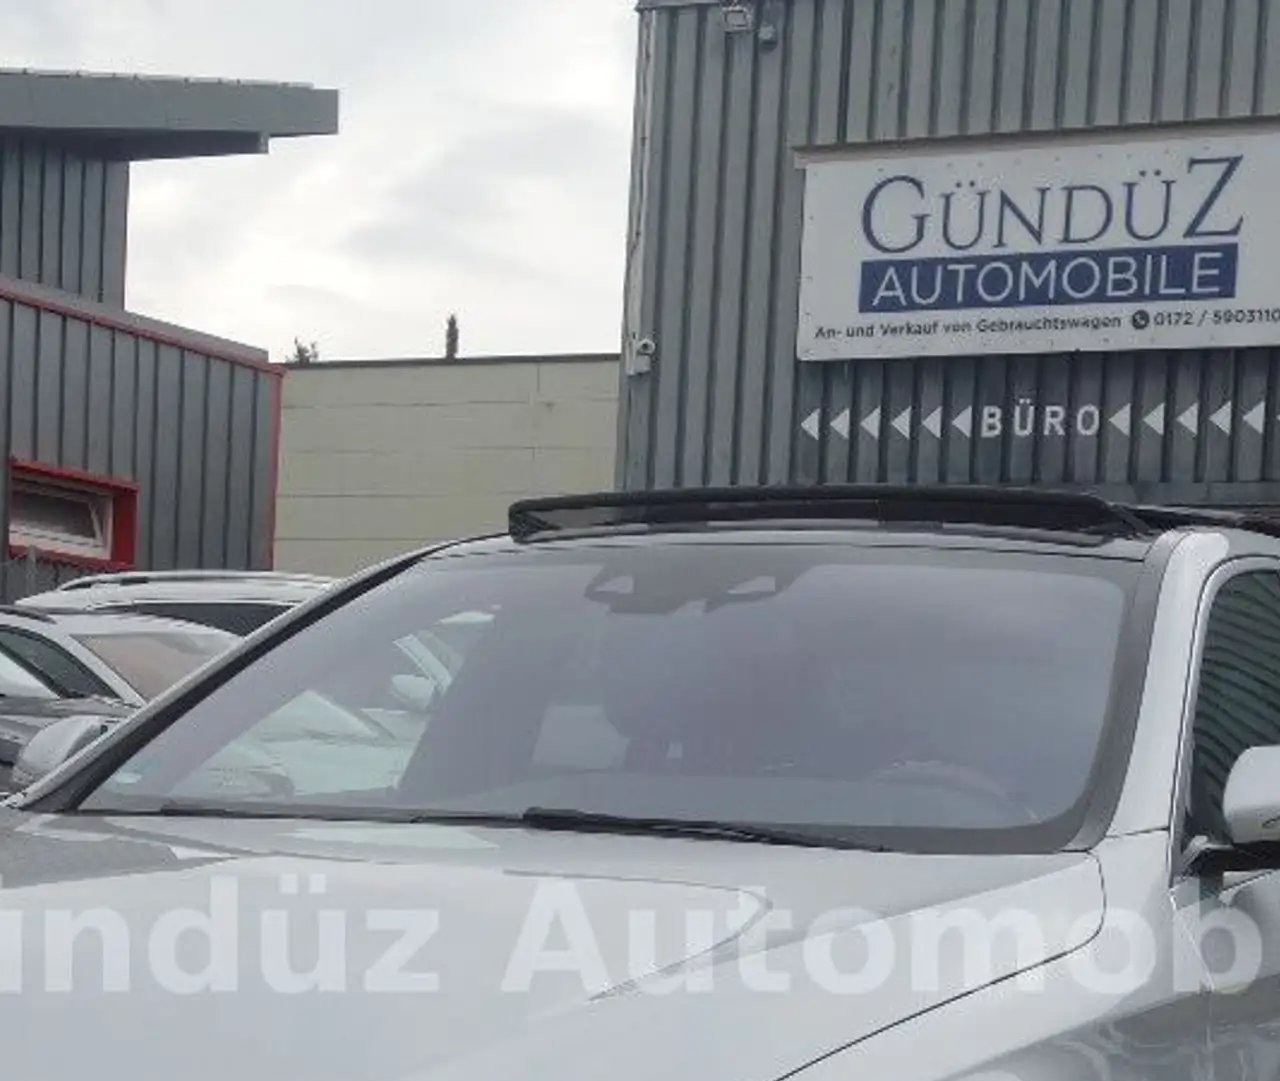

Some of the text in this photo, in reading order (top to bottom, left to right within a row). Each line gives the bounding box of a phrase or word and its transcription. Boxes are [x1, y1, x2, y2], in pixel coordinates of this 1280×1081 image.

[872, 252, 1223, 306] AUTOMOBILE
[815, 324, 842, 338] An-
[846, 323, 875, 338] und
[880, 321, 939, 336] Verkauf
[943, 321, 971, 333] von
[976, 314, 1122, 333] Gebrauchtswagen
[1153, 311, 1194, 326] 0172
[980, 399, 1102, 438] BÜRO
